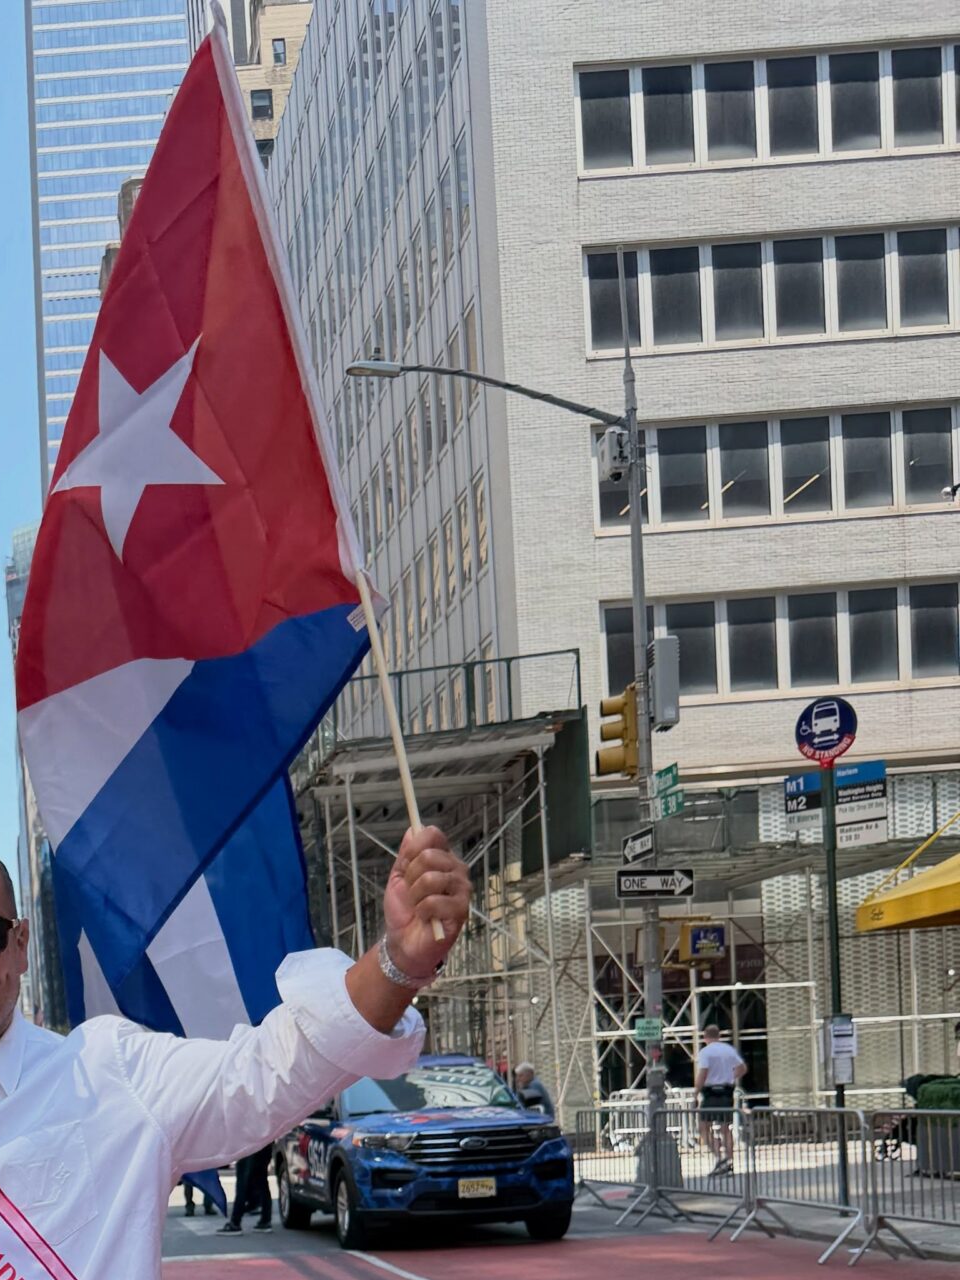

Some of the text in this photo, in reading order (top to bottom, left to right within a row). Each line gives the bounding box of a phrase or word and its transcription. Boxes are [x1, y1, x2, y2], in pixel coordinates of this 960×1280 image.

[802, 737, 851, 759] NO STANDING
[786, 776, 804, 793] M1
[787, 796, 807, 812] M2
[627, 841, 650, 856] ONE WAY
[623, 877, 683, 889] ONE WAY
